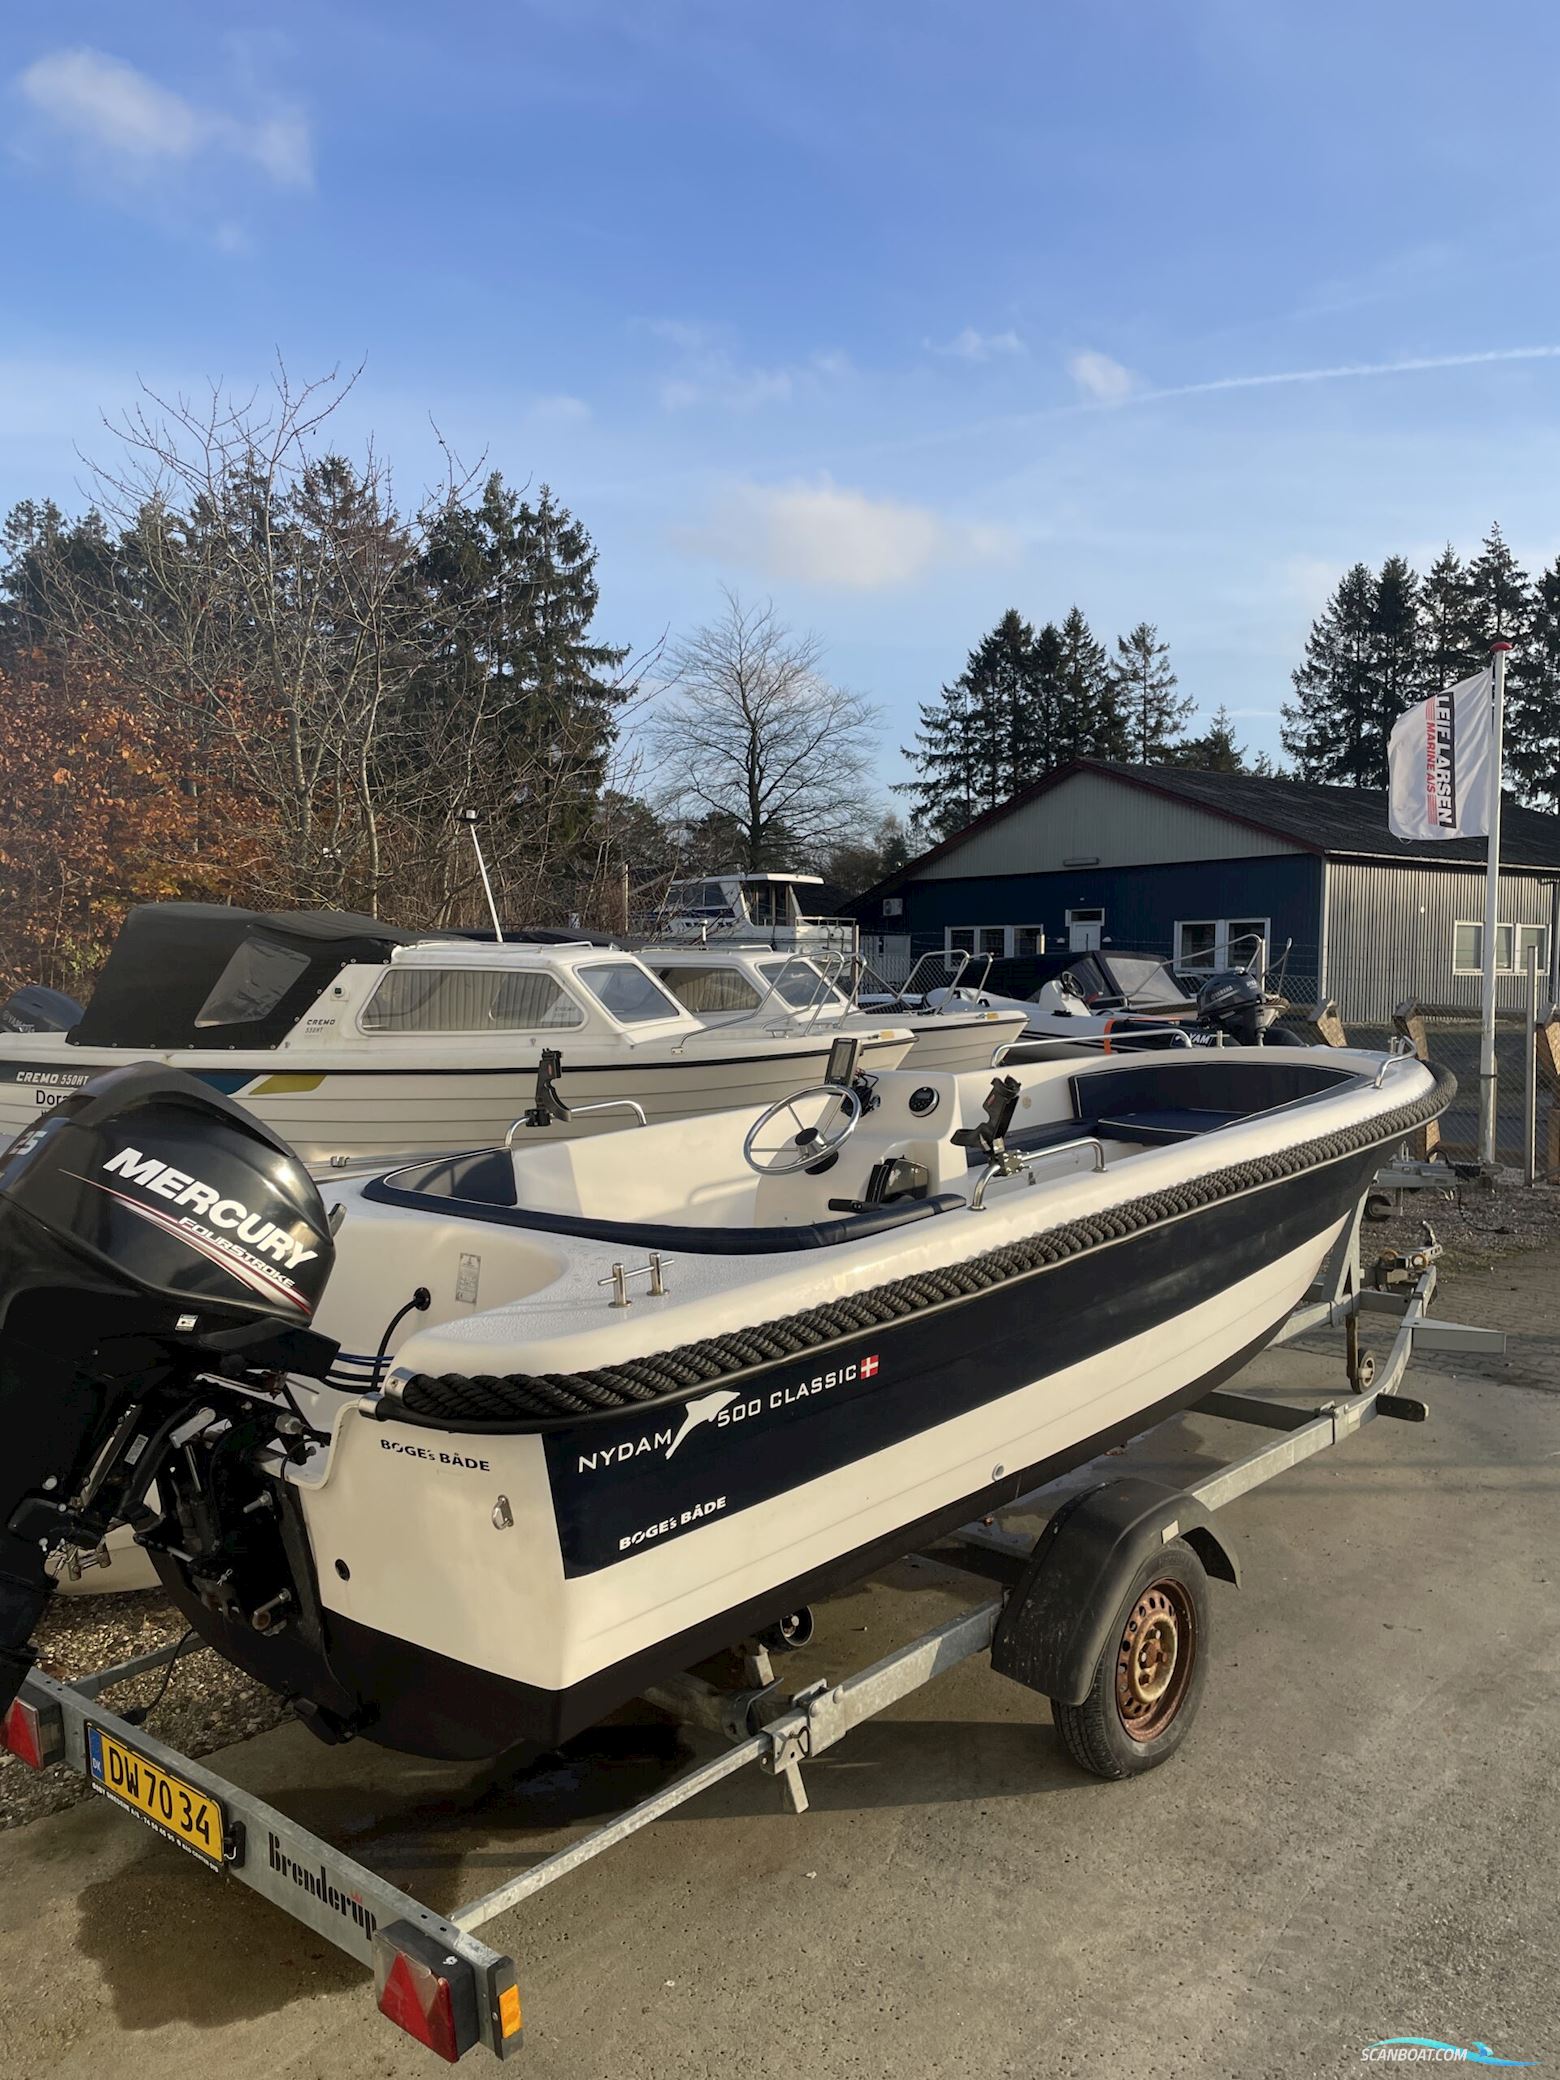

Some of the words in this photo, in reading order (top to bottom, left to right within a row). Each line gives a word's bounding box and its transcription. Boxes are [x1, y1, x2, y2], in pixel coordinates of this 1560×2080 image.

[1437, 695, 1451, 740] LEIF
[1426, 722, 1436, 772] MARINE
[1427, 773, 1436, 793] A/S
[1437, 744, 1453, 823] LARSEN
[16, 1071, 59, 1084] CREMO
[60, 1074, 89, 1086] 550HT
[102, 1147, 319, 1270] MERCURY
[176, 1216, 296, 1289] FOURSTROKE
[717, 1398, 762, 1428] 500
[769, 1364, 858, 1409] CLASSIC
[439, 1451, 491, 1472] BÅDE
[578, 1429, 673, 1474] NYDAM
[680, 1495, 727, 1527] BÅDE
[92, 1756, 103, 1773] DK
[109, 1745, 139, 1800] DW
[143, 1768, 173, 1821] 70
[179, 1790, 210, 1846] 34
[268, 1831, 377, 1942] Brenderup
